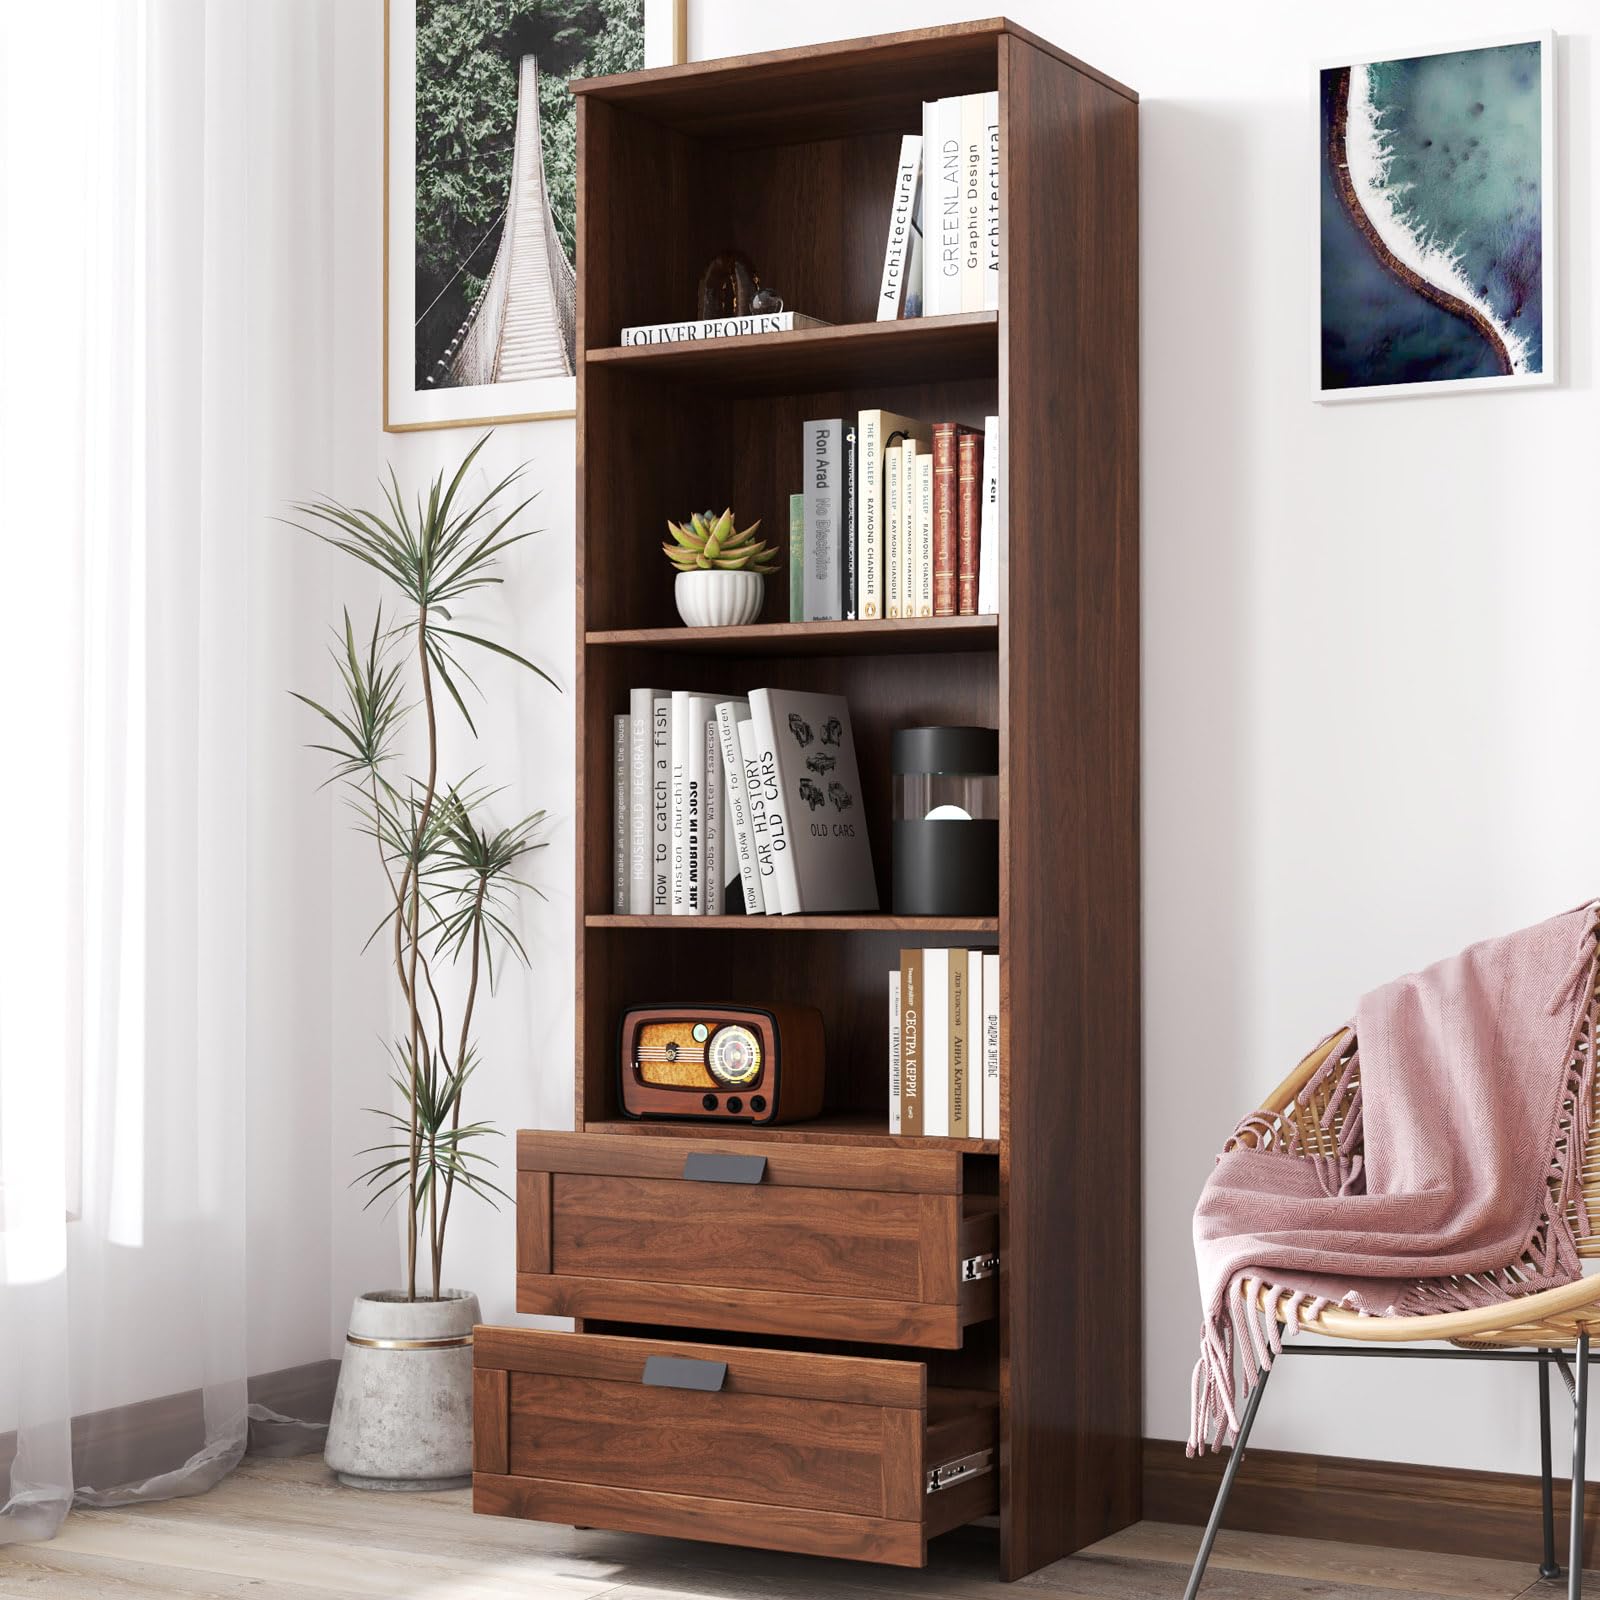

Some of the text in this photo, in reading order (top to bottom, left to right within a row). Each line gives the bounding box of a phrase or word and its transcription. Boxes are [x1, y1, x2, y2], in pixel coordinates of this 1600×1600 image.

[943, 140, 959, 277] GREENLAND
[967, 144, 980, 268] Graphic Design
[884, 163, 914, 300] Architectural
[634, 326, 697, 346] OLIVER
[704, 316, 780, 339] PEOPLES
[816, 429, 830, 455] Ron
[816, 459, 830, 489] Arad
[720, 708, 734, 763] children
[617, 766, 624, 776] in
[634, 719, 644, 795] DECORATES
[654, 707, 666, 906] How to catch a fish
[744, 758, 774, 876] CAR HISTORY
[760, 751, 786, 851] OLD CARS
[617, 838, 624, 848] an
[674, 764, 682, 904] Winston Churchill
[708, 828, 717, 840] by
[738, 832, 750, 860] DRAW
[811, 824, 855, 837] OLD CARS
[617, 877, 624, 887] to
[744, 866, 752, 880] TO
[746, 887, 756, 909] HOW
[906, 1010, 916, 1056] СЕСТРА
[906, 1059, 916, 1097] КЕРРИ
